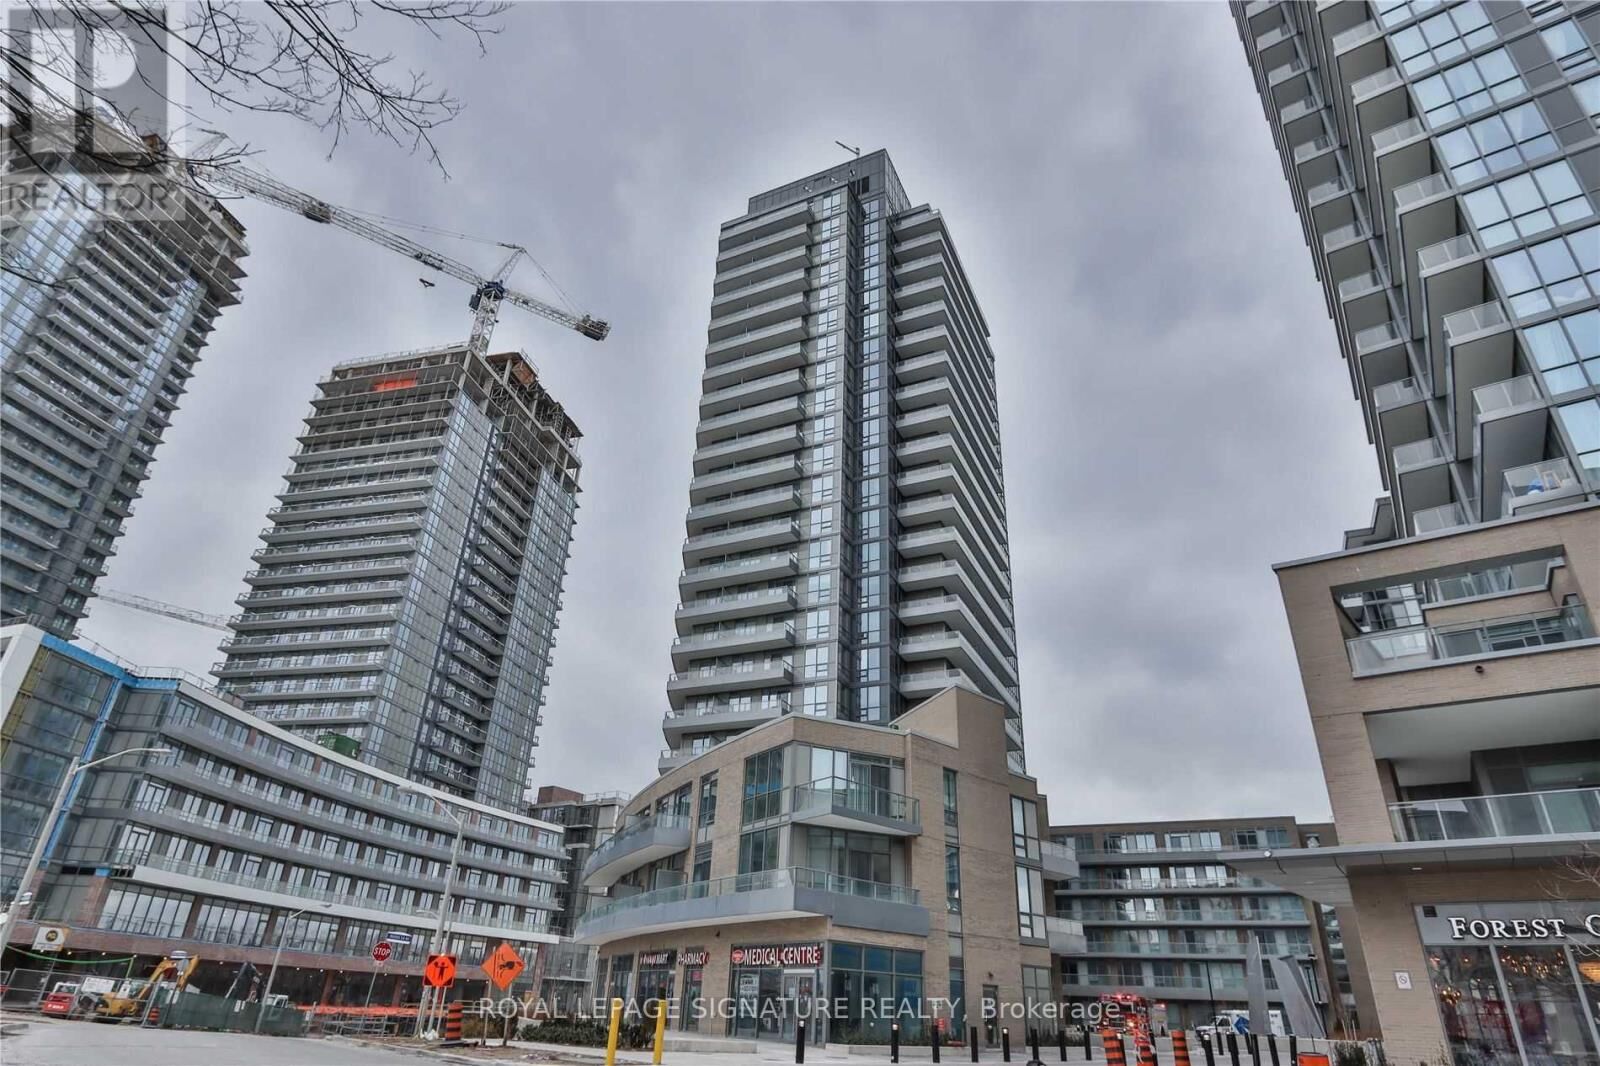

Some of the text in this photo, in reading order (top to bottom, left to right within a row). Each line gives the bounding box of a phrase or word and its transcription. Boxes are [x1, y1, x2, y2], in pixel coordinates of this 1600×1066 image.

[1448, 917, 1566, 938] FOREST
[374, 947, 391, 957] STOP
[744, 948, 781, 966] MEDICAL
[783, 946, 818, 965] CENTRE
